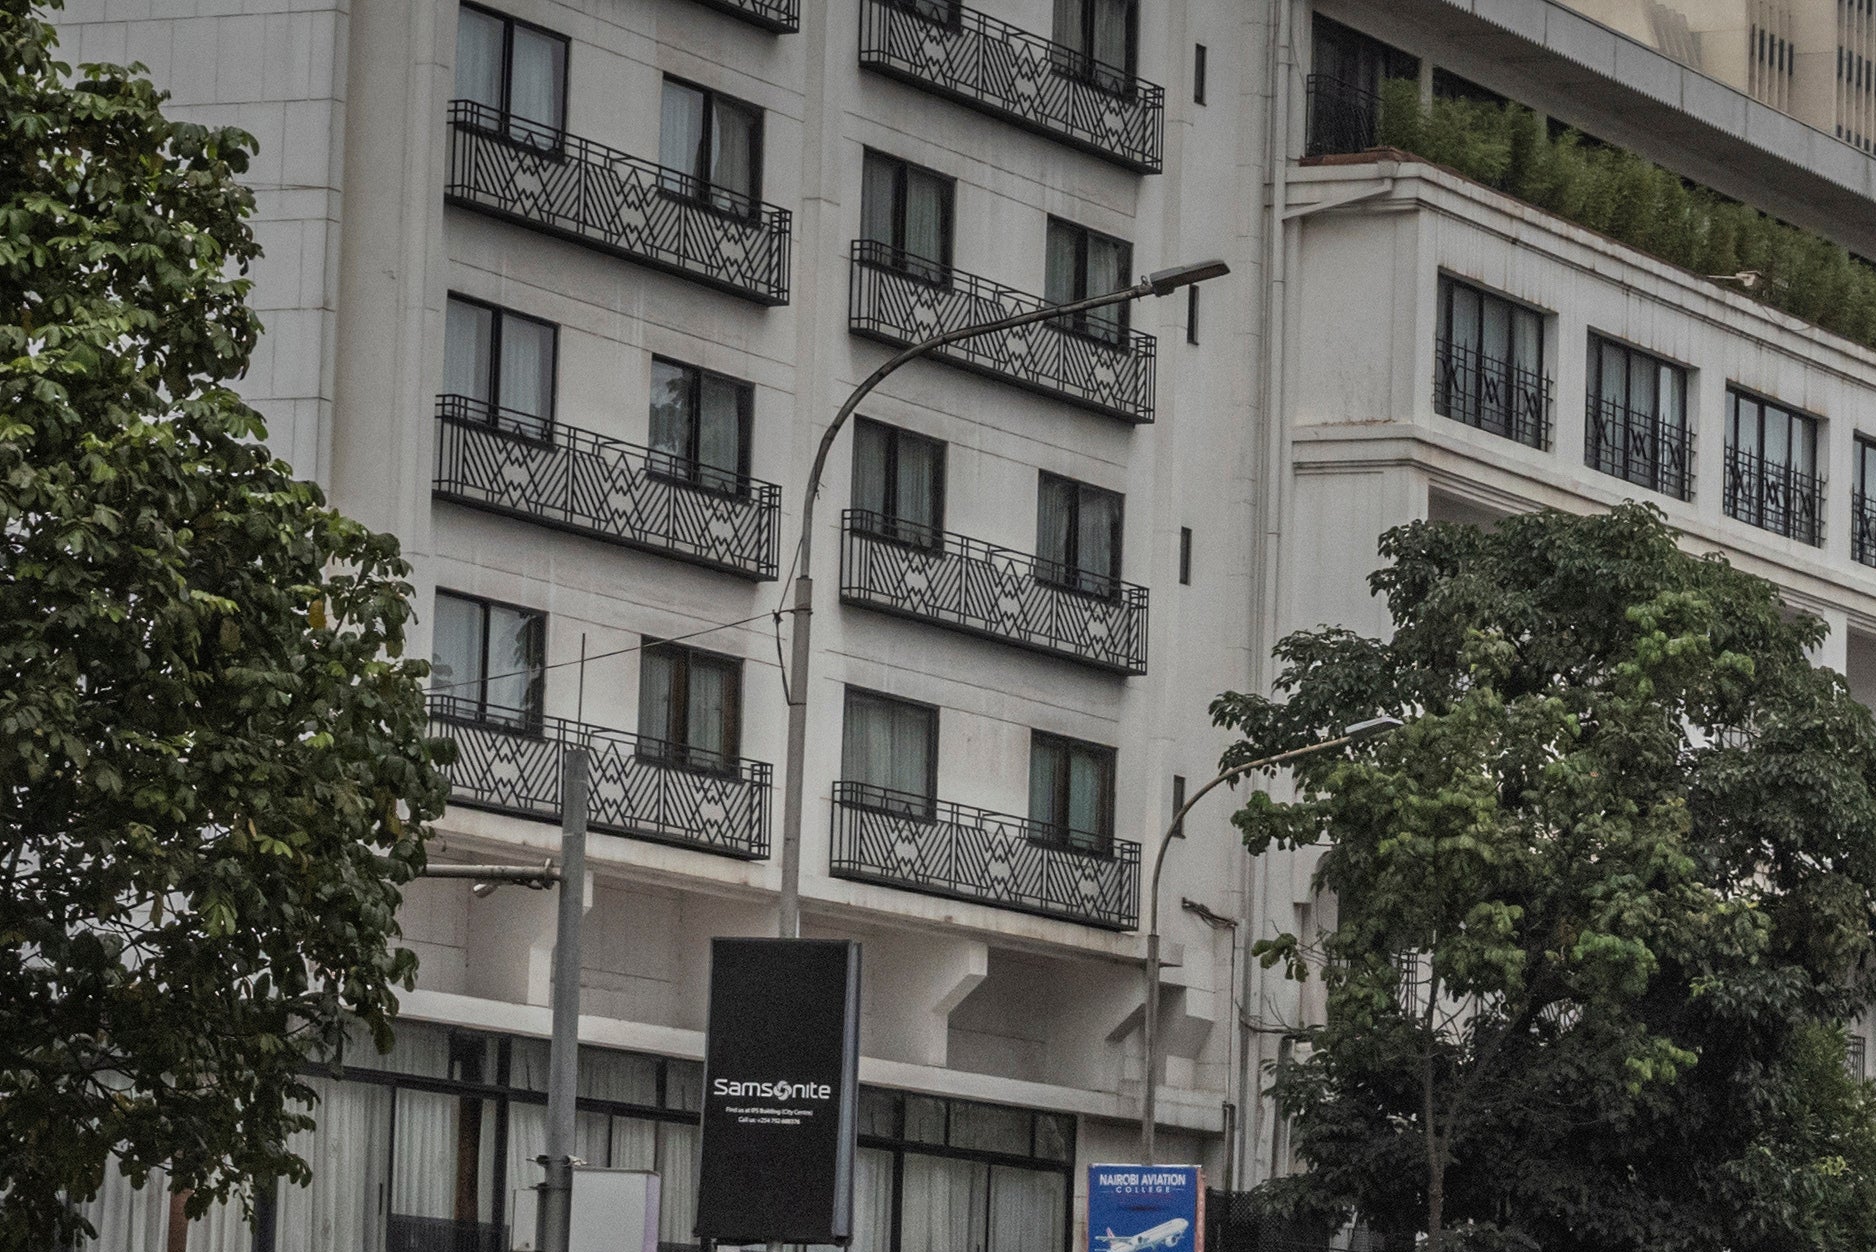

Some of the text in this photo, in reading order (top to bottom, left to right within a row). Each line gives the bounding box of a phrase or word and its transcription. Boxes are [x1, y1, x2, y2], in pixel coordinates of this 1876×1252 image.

[714, 1078, 831, 1101] Samsonite
[1100, 1174, 1186, 1186] NAIROBI AVIATION
[1115, 1186, 1170, 1194] COLLEGE
